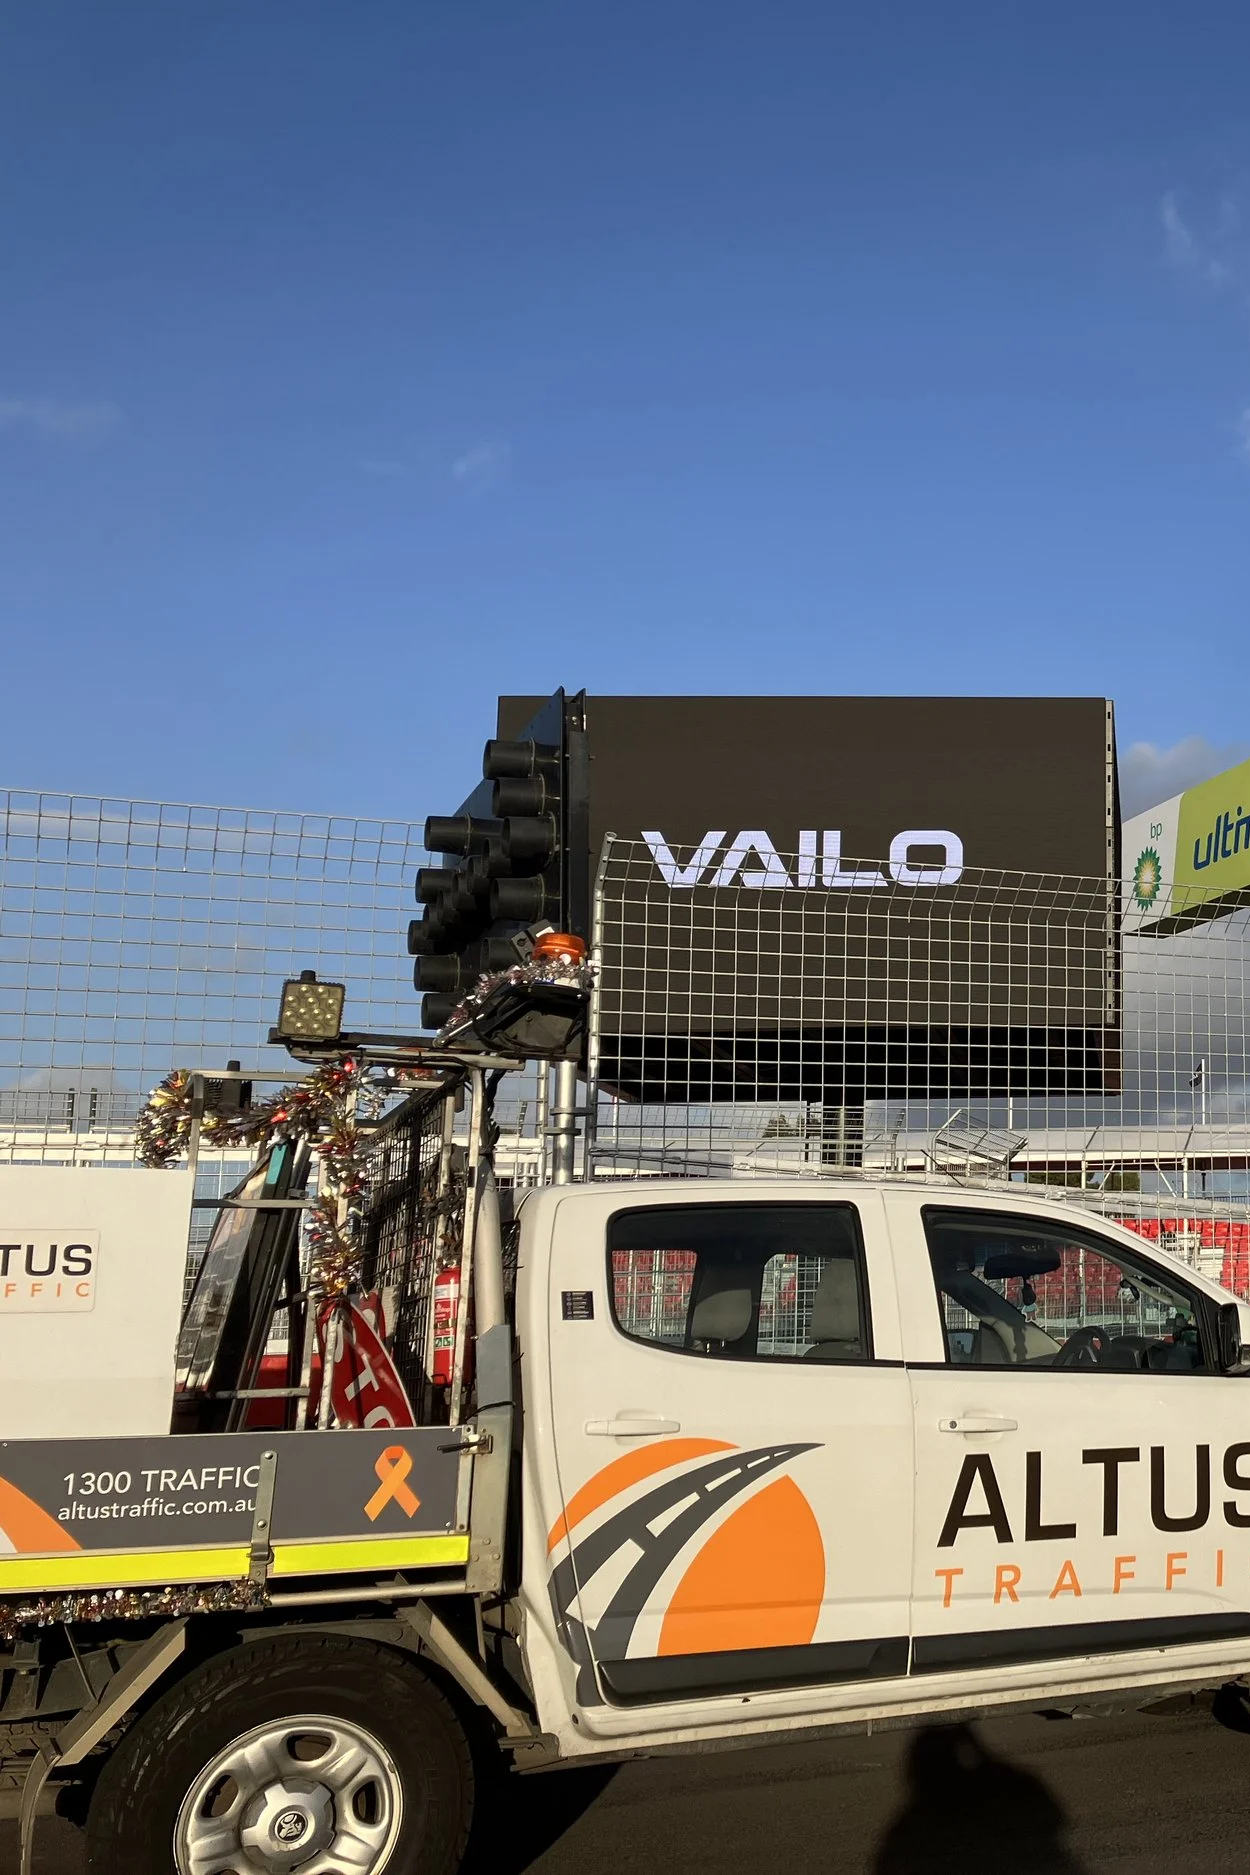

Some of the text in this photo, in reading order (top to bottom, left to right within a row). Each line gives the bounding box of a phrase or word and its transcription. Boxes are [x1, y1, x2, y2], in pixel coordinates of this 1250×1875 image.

[1149, 822, 1163, 841] bp
[640, 830, 964, 889] VAILO
[63, 1465, 260, 1496] 1300 TRAFFIC
